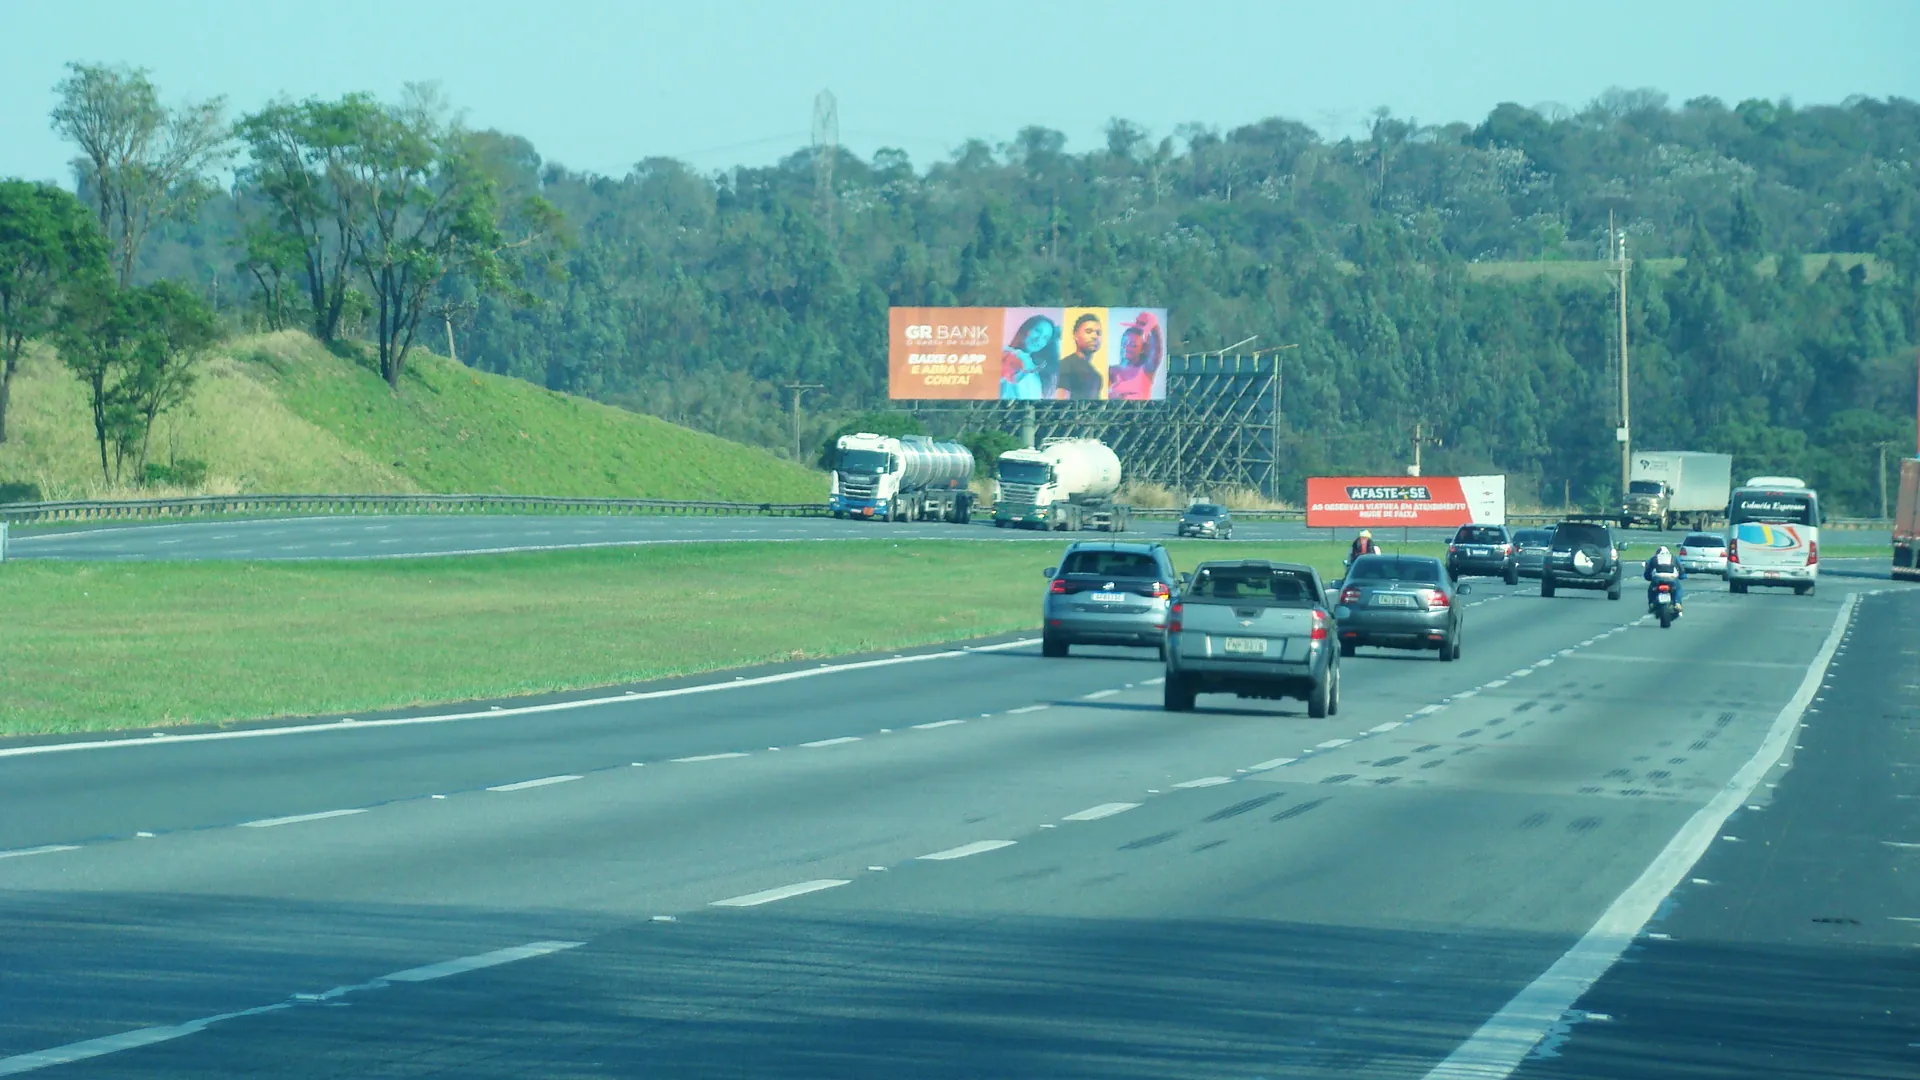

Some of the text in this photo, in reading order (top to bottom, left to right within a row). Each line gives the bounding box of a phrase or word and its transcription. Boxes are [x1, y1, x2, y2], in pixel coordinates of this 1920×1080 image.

[905, 325, 988, 339] GR BANK
[908, 353, 986, 364] BAIXE O APP
[912, 364, 982, 374] E ABRA SUA
[924, 375, 970, 385] CONTA!
[1413, 502, 1466, 510] ATENDIMENTO
